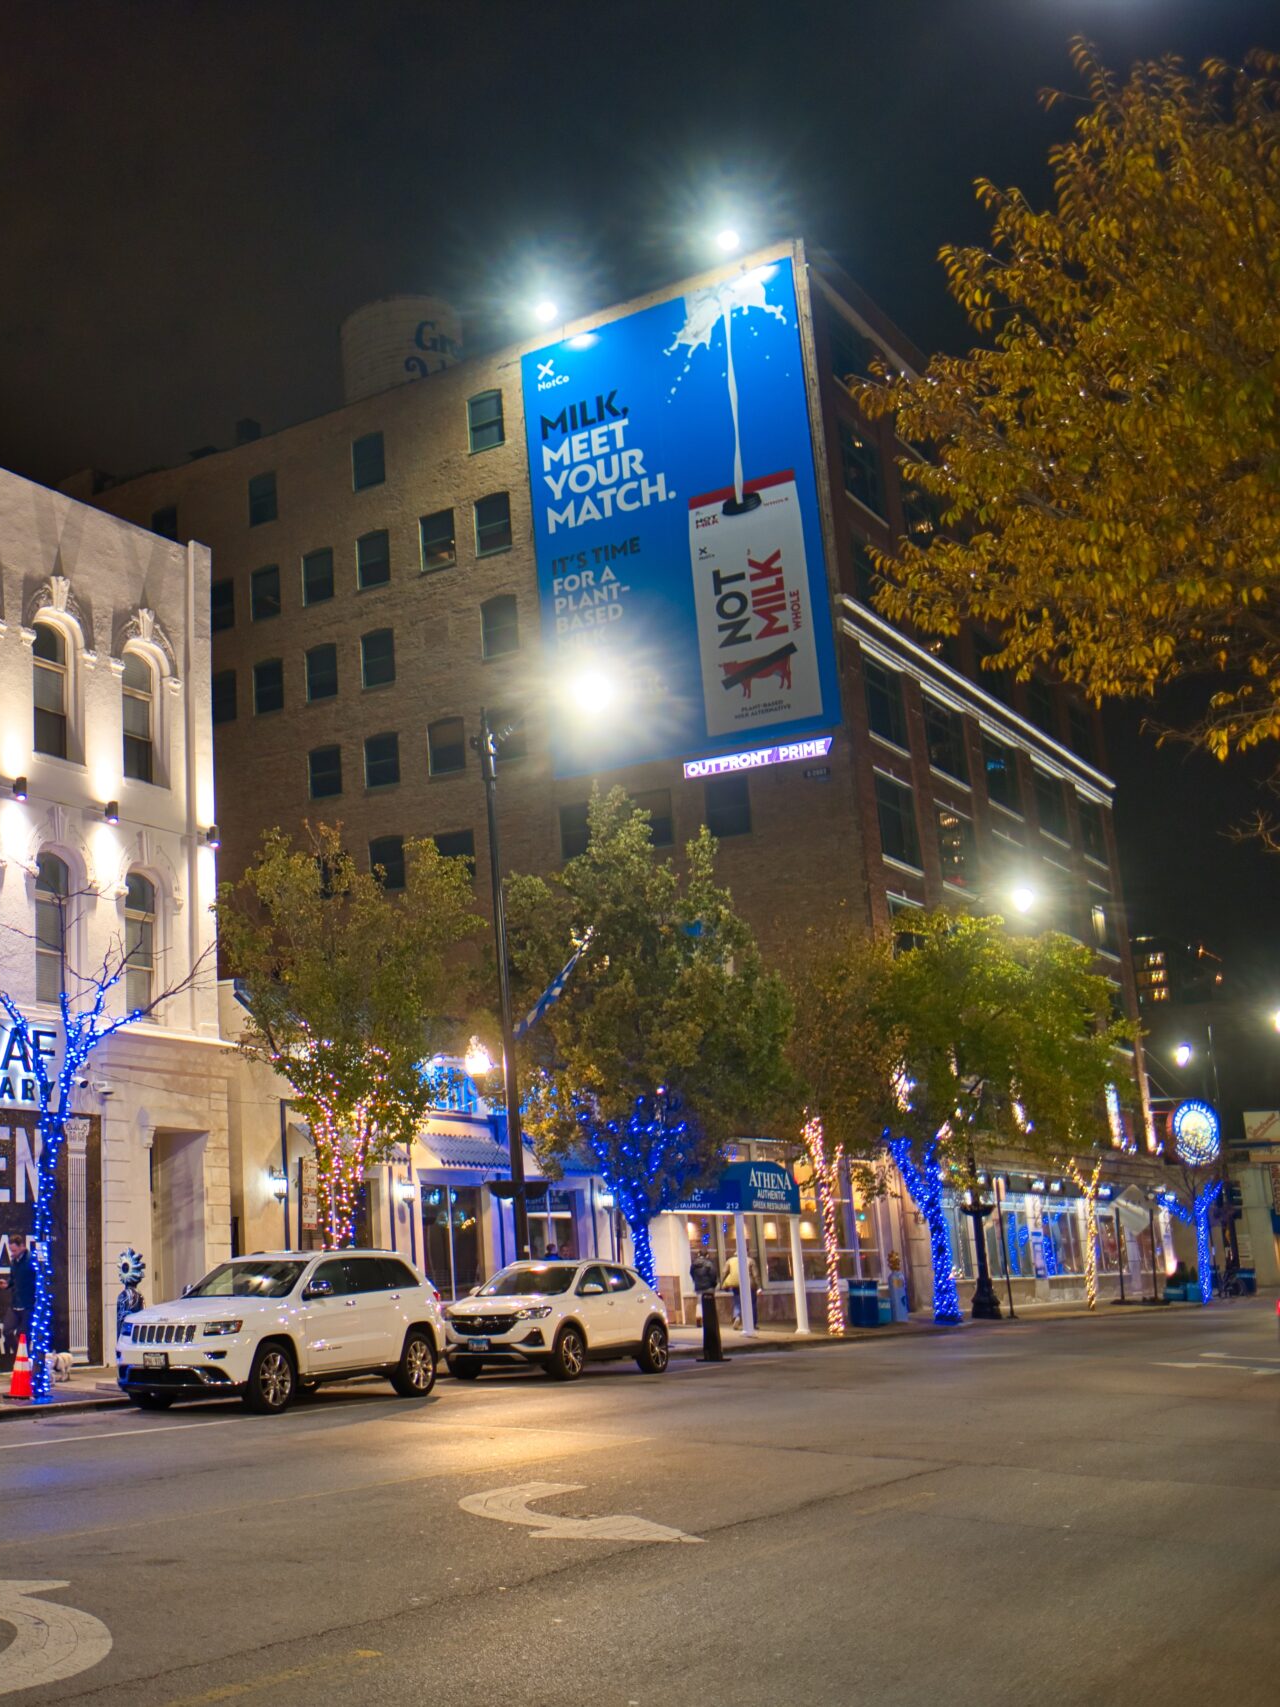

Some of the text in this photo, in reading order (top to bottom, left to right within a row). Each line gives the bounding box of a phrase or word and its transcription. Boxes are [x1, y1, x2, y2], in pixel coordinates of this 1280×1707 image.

[538, 375, 570, 392] NotCo
[540, 389, 629, 441] MILK,
[542, 418, 629, 472] MEET
[543, 448, 647, 501] YOUR
[547, 472, 677, 535] MATCH.
[552, 536, 641, 576] IT'S TIME
[553, 565, 616, 596] FOR A
[554, 582, 631, 615] PLANT-
[747, 548, 789, 640] MILK
[556, 603, 624, 635] BASED
[712, 568, 752, 649] NOT
[789, 589, 801, 631] WHOLE
[687, 741, 825, 776] OUTFRONT PRIME
[749, 1167, 792, 1191] ATHENA
[758, 1189, 786, 1201] AUTHENTIC
[752, 1200, 766, 1209] GREEK
